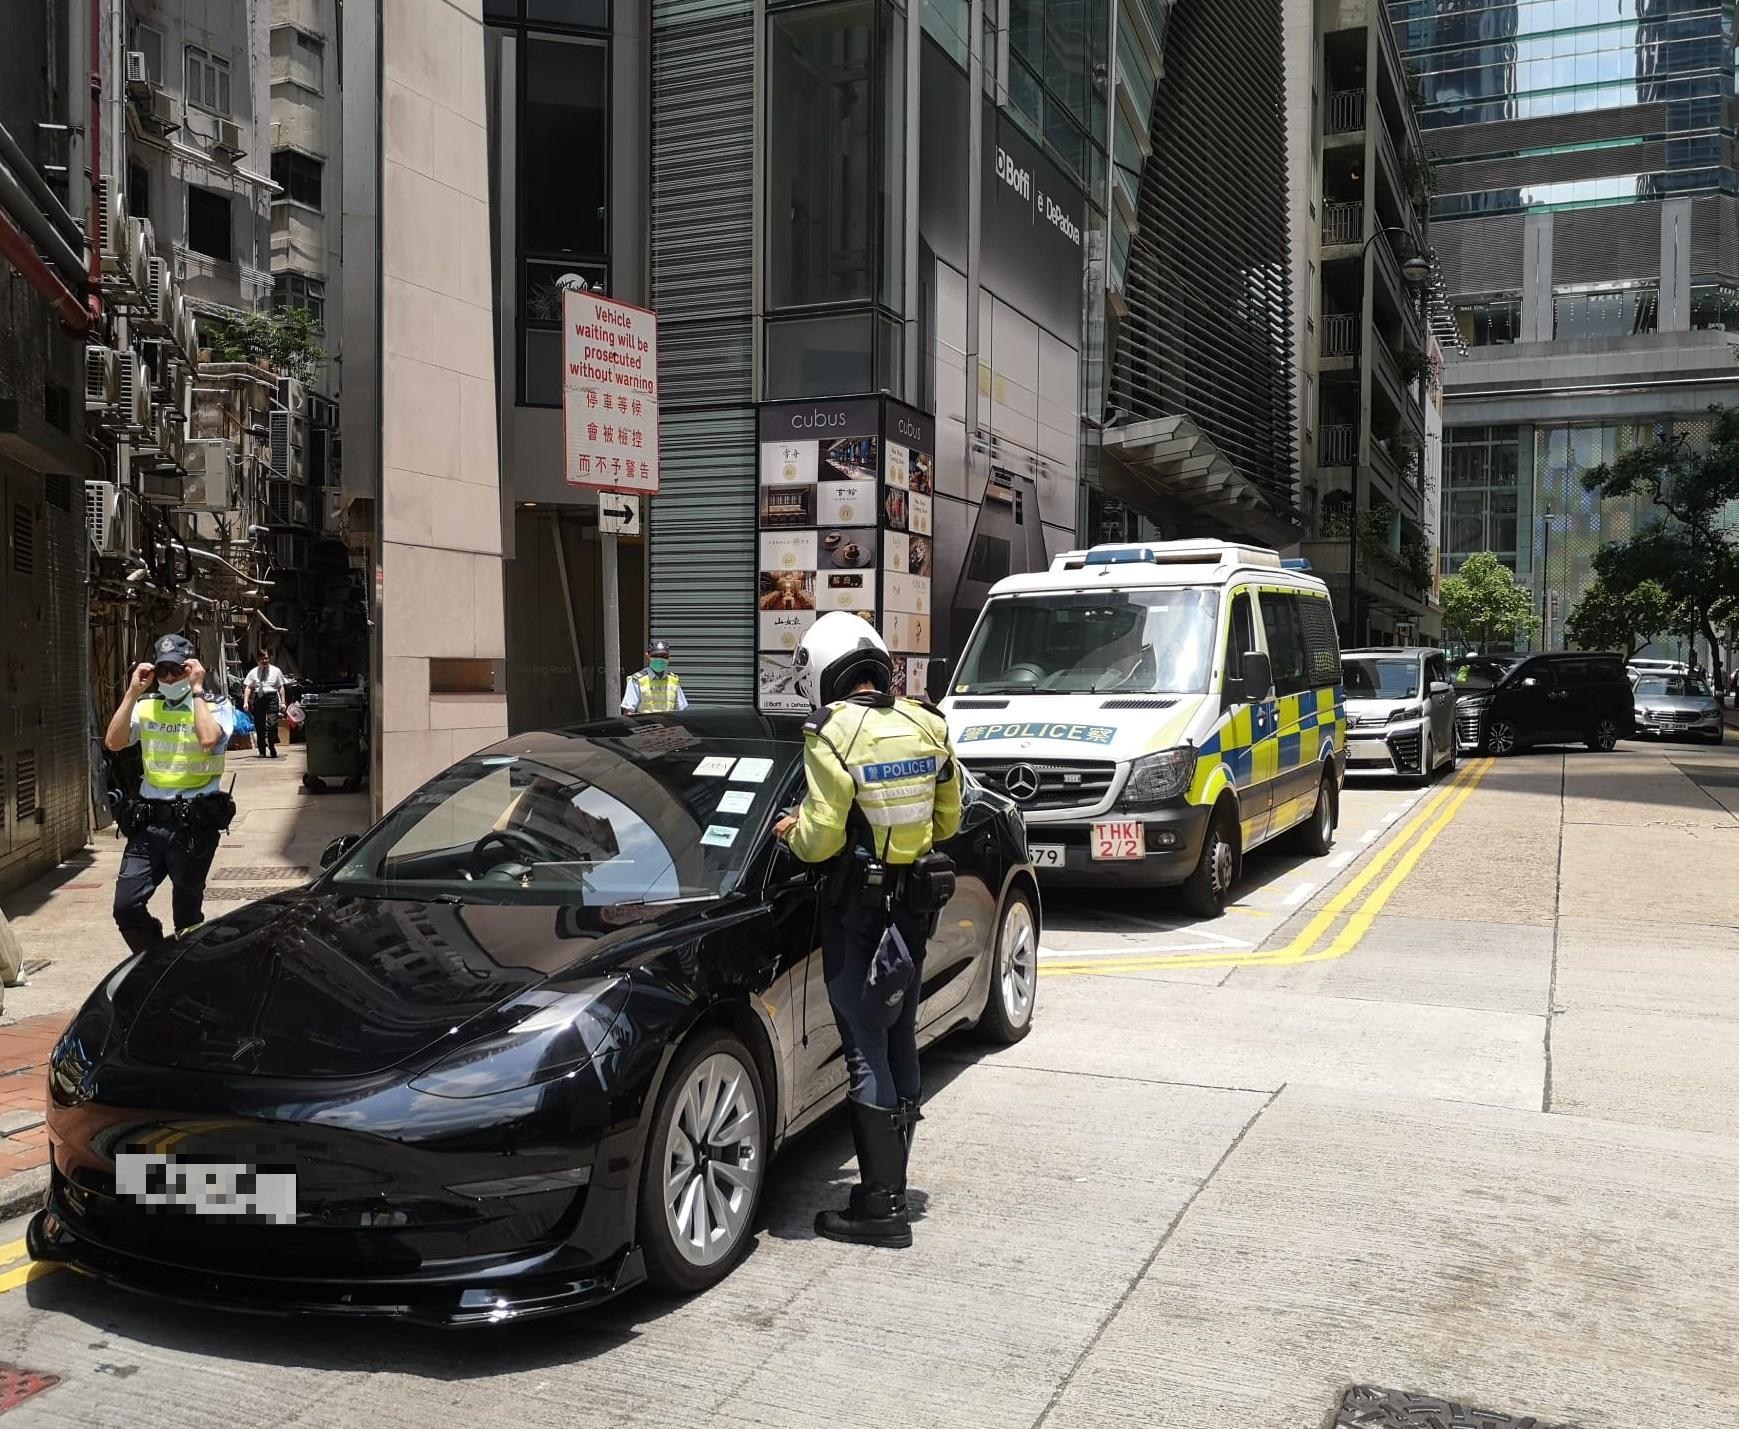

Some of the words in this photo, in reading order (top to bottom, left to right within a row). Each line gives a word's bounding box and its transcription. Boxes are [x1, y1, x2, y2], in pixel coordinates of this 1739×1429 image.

[1006, 154, 1030, 201] Boffi
[595, 305, 632, 329] Vehicle
[575, 323, 615, 347] waiting
[618, 333, 635, 350] will
[638, 336, 649, 352] be
[584, 345, 641, 369] prosecuted
[570, 361, 612, 383] without
[615, 372, 654, 394] warning
[586, 389, 642, 417] 停車等候
[791, 408, 846, 429] cubus
[898, 418, 921, 441] cubus
[586, 422, 643, 448] 會被檢控
[578, 453, 649, 480] 而不予警告
[984, 723, 1087, 740] POLICE
[882, 760, 926, 778] POLICE
[1100, 840, 1138, 857] 2/2
